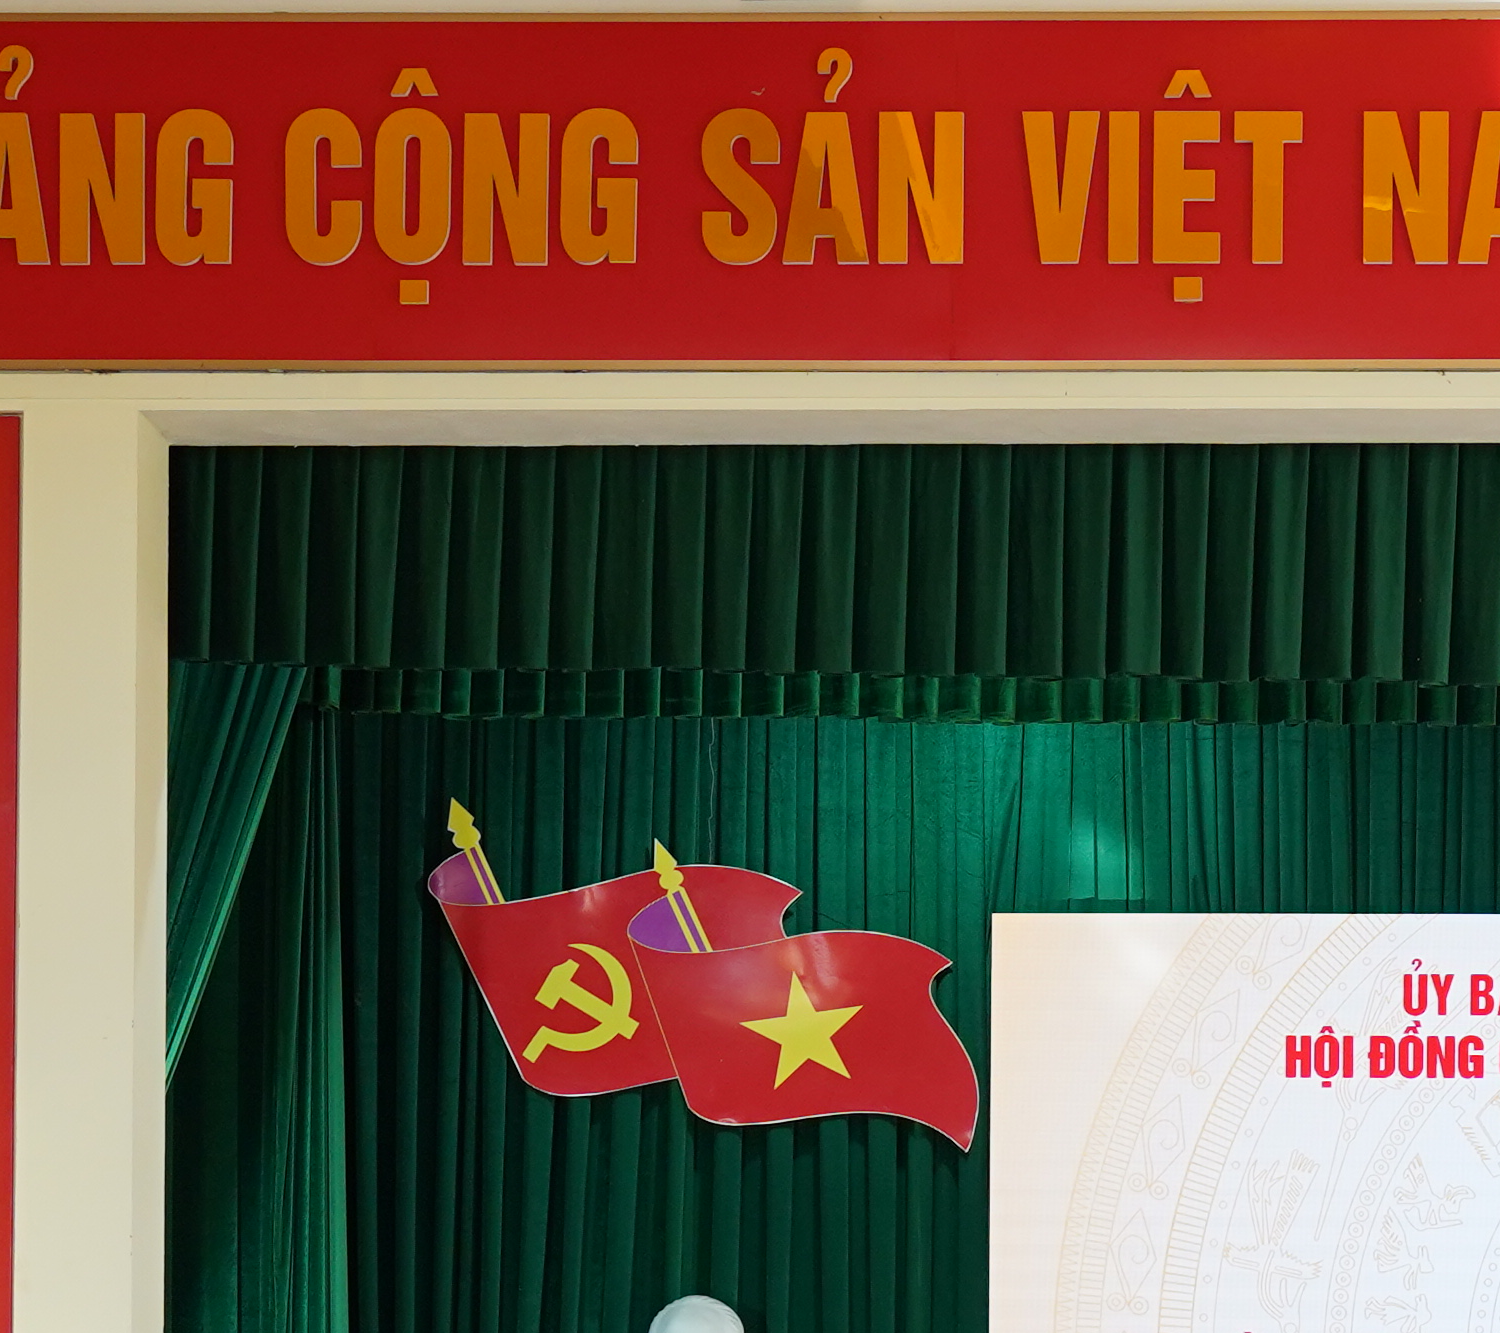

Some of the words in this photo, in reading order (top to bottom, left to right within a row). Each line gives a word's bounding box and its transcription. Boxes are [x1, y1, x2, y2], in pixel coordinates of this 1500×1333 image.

[286, 68, 638, 304] CỘNG
[702, 48, 964, 265] SẢN
[1022, 70, 1303, 302] VIỆT
[1403, 959, 1454, 1016] ỦY
[1285, 1026, 1354, 1088] HỘI
[1368, 1021, 1484, 1078] ĐỒNG
